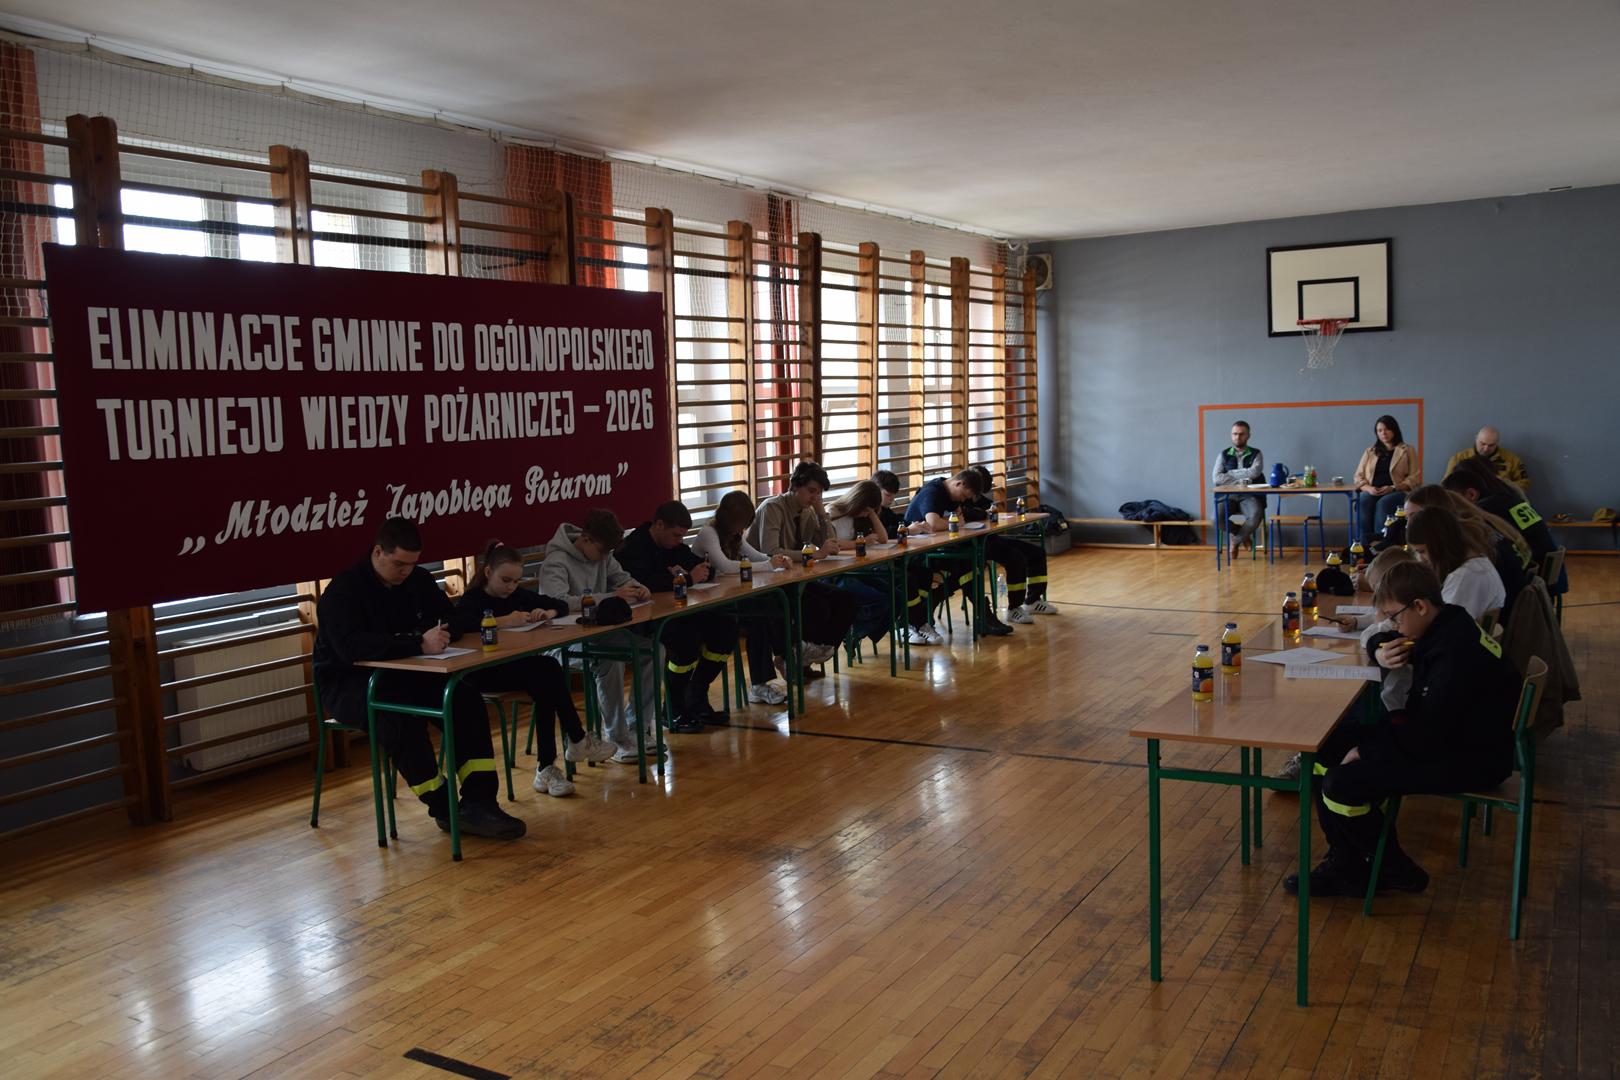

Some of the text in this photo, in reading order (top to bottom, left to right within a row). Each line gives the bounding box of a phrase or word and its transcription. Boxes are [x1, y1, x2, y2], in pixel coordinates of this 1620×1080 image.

[87, 306, 655, 372] ELIMINACJE GMINNE DO OGÓLNOPOLSKIEGO
[97, 396, 284, 460] TURNIEJU
[301, 393, 409, 450] WIEDZY
[425, 386, 575, 443] POŻARNICZEJ
[606, 387, 655, 432] 2026
[385, 479, 513, 525] Zapobiega
